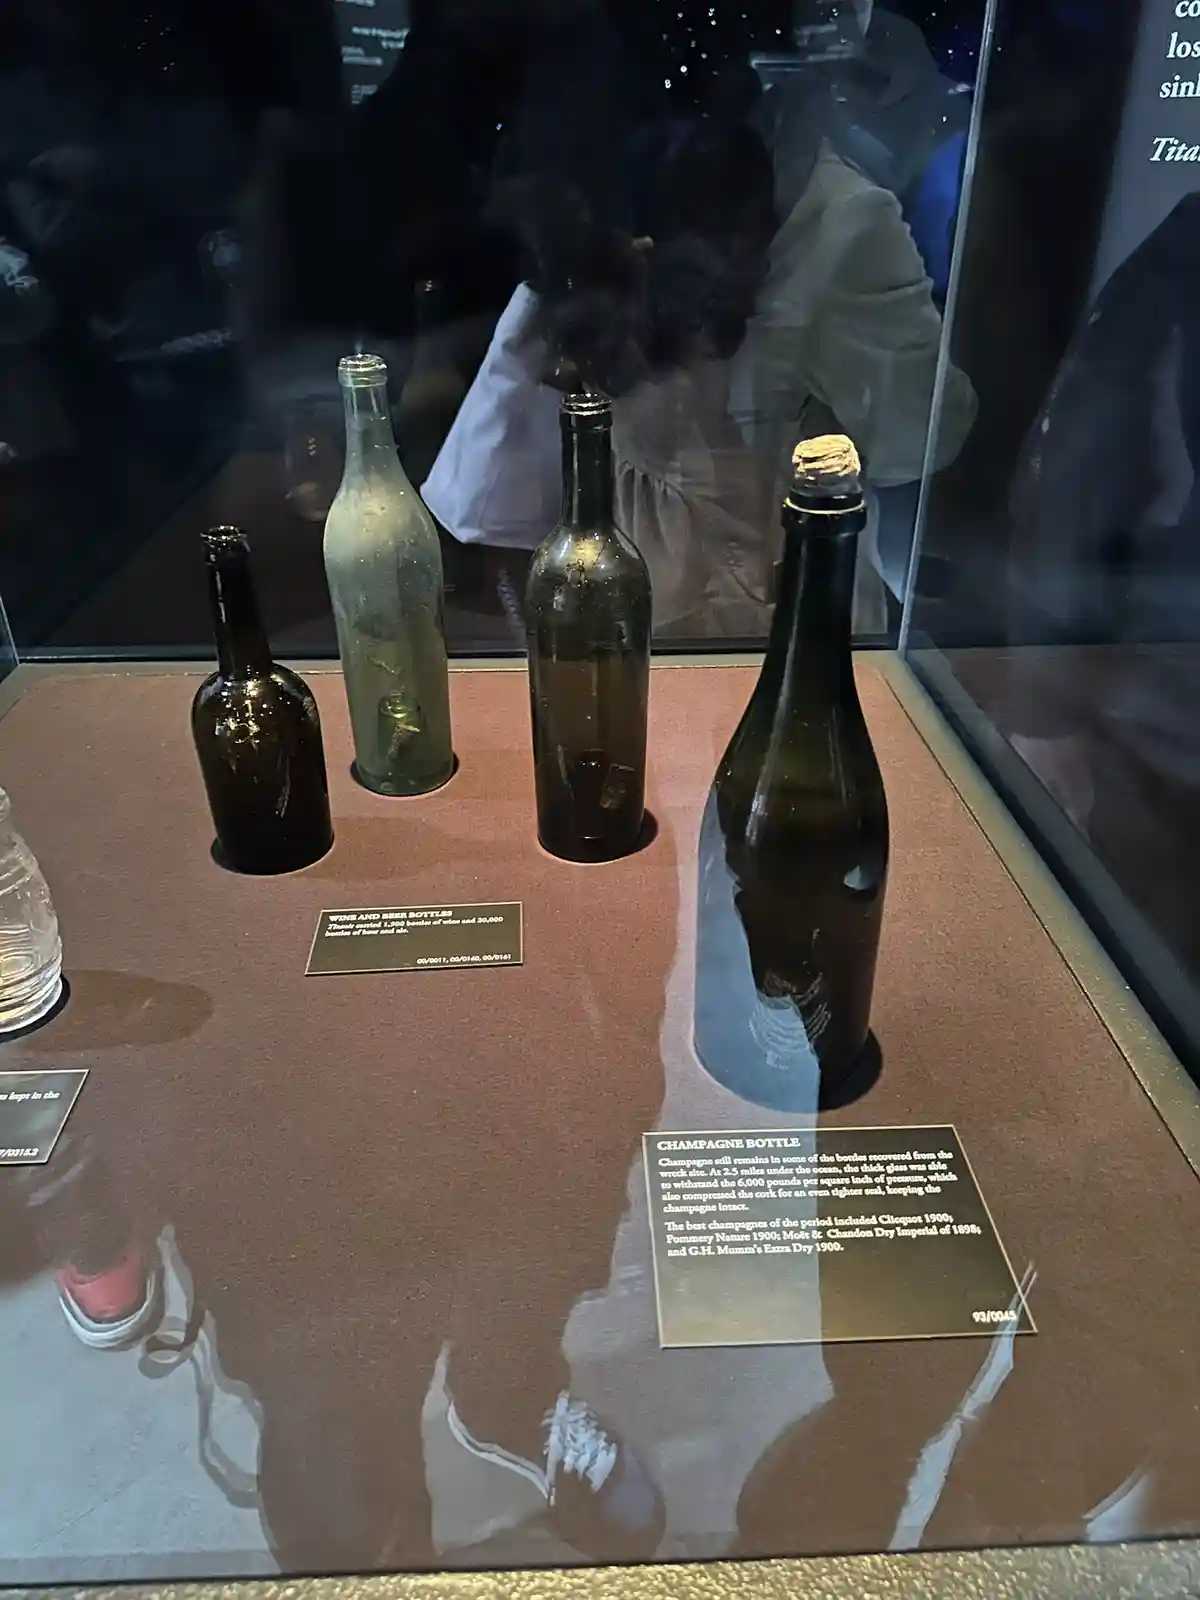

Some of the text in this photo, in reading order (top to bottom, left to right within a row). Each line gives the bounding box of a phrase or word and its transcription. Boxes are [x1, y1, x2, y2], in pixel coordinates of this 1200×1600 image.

[1159, 72, 1200, 98] sin
[1149, 137, 1200, 162] Tita
[409, 910, 453, 918] BOTTLES
[31, 1091, 42, 1099] in
[43, 1090, 61, 1099] the
[657, 1136, 801, 1151] CHAMPAGNE BOTTLE
[659, 1150, 954, 1168] Champagne still remains in some of the bottles recovered from the
[659, 1161, 948, 1178] wreck site. At 2.5 miles under the ocean, the thick glass was able
[661, 1172, 958, 1190] to withstand the 6,000 pounds per square inch of pressure, which
[662, 1183, 942, 1202] also compressed the cork for an even tighter seal, keeping the
[663, 1202, 750, 1214] champagne intact.
[664, 1220, 684, 1231] The
[686, 1220, 706, 1230] best
[707, 1219, 768, 1231] champagnes
[769, 1217, 781, 1228] of
[782, 1217, 799, 1227] the
[800, 1217, 832, 1229] period
[834, 1214, 878, 1226] included
[878, 1213, 923, 1226] Clicquot
[666, 1233, 714, 1245] Pommery
[811, 1230, 823, 1239] &
[826, 1228, 873, 1239] Chandon
[874, 1227, 895, 1239] Dry
[896, 1225, 938, 1238] Imperial
[939, 1224, 951, 1235] of
[667, 1241, 844, 1257] and G.H. Mumm's Extra Dry 1900.
